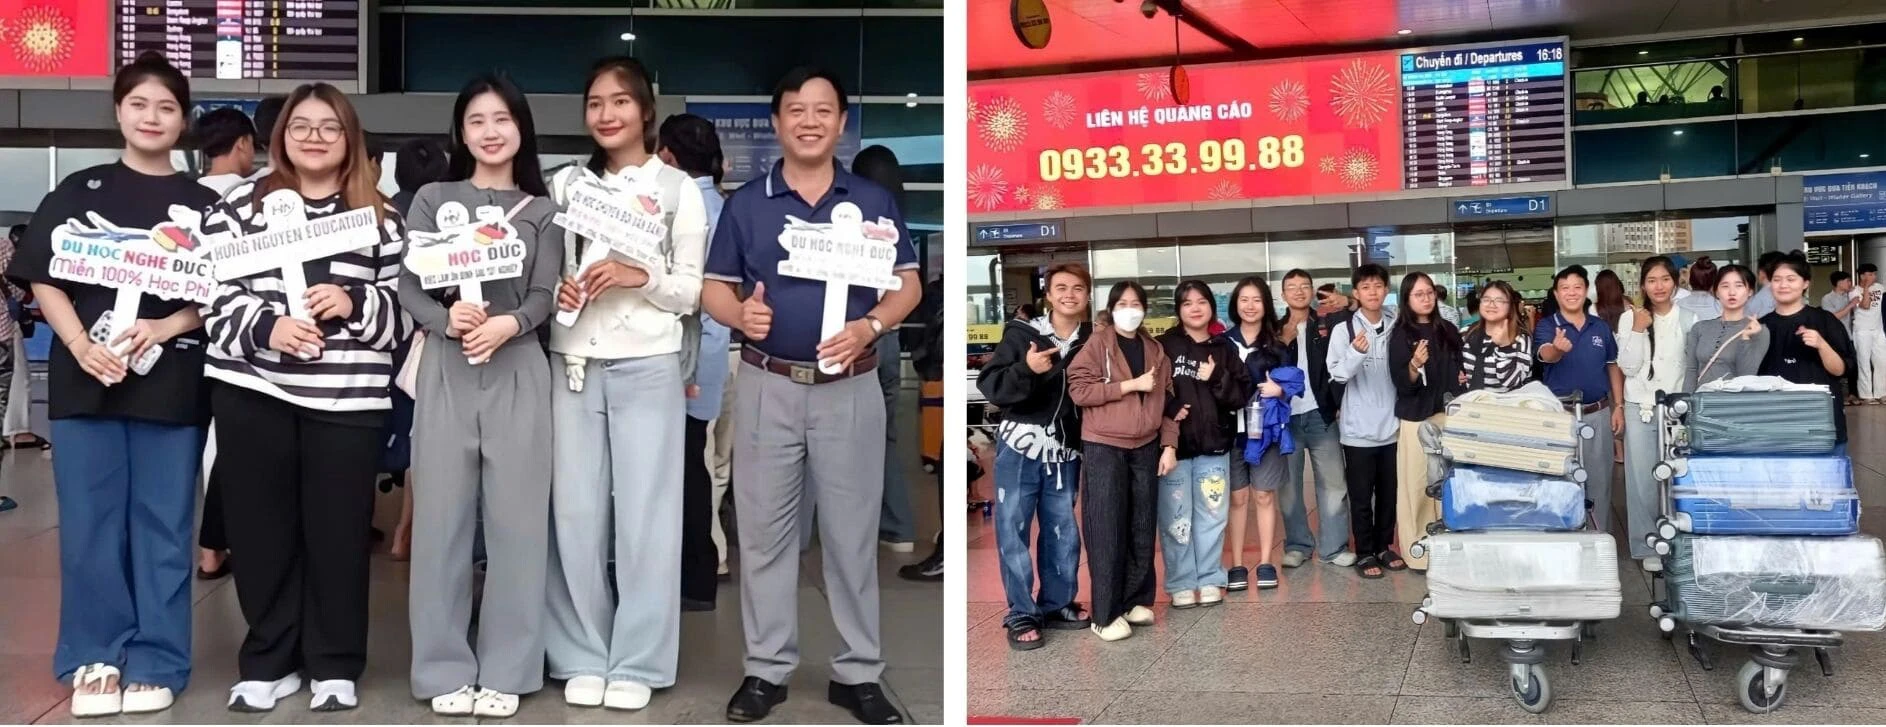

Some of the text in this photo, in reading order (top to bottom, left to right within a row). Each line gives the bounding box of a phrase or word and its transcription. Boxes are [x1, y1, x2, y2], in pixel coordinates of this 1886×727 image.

[1471, 50, 1523, 69] Departures
[1536, 48, 1563, 61] 16:18
[1086, 108, 1123, 128] LIÊN
[1128, 106, 1149, 128] HỆ
[1217, 100, 1253, 120] CÁO
[1039, 134, 1305, 182] 0933.33.99.88
[1529, 199, 1545, 211] D1
[306, 211, 374, 239] EDUCATION
[1040, 225, 1056, 236] D1
[61, 239, 83, 253] DU
[448, 249, 481, 267] HỌC
[102, 266, 143, 286] 100%
[149, 274, 180, 294] Học
